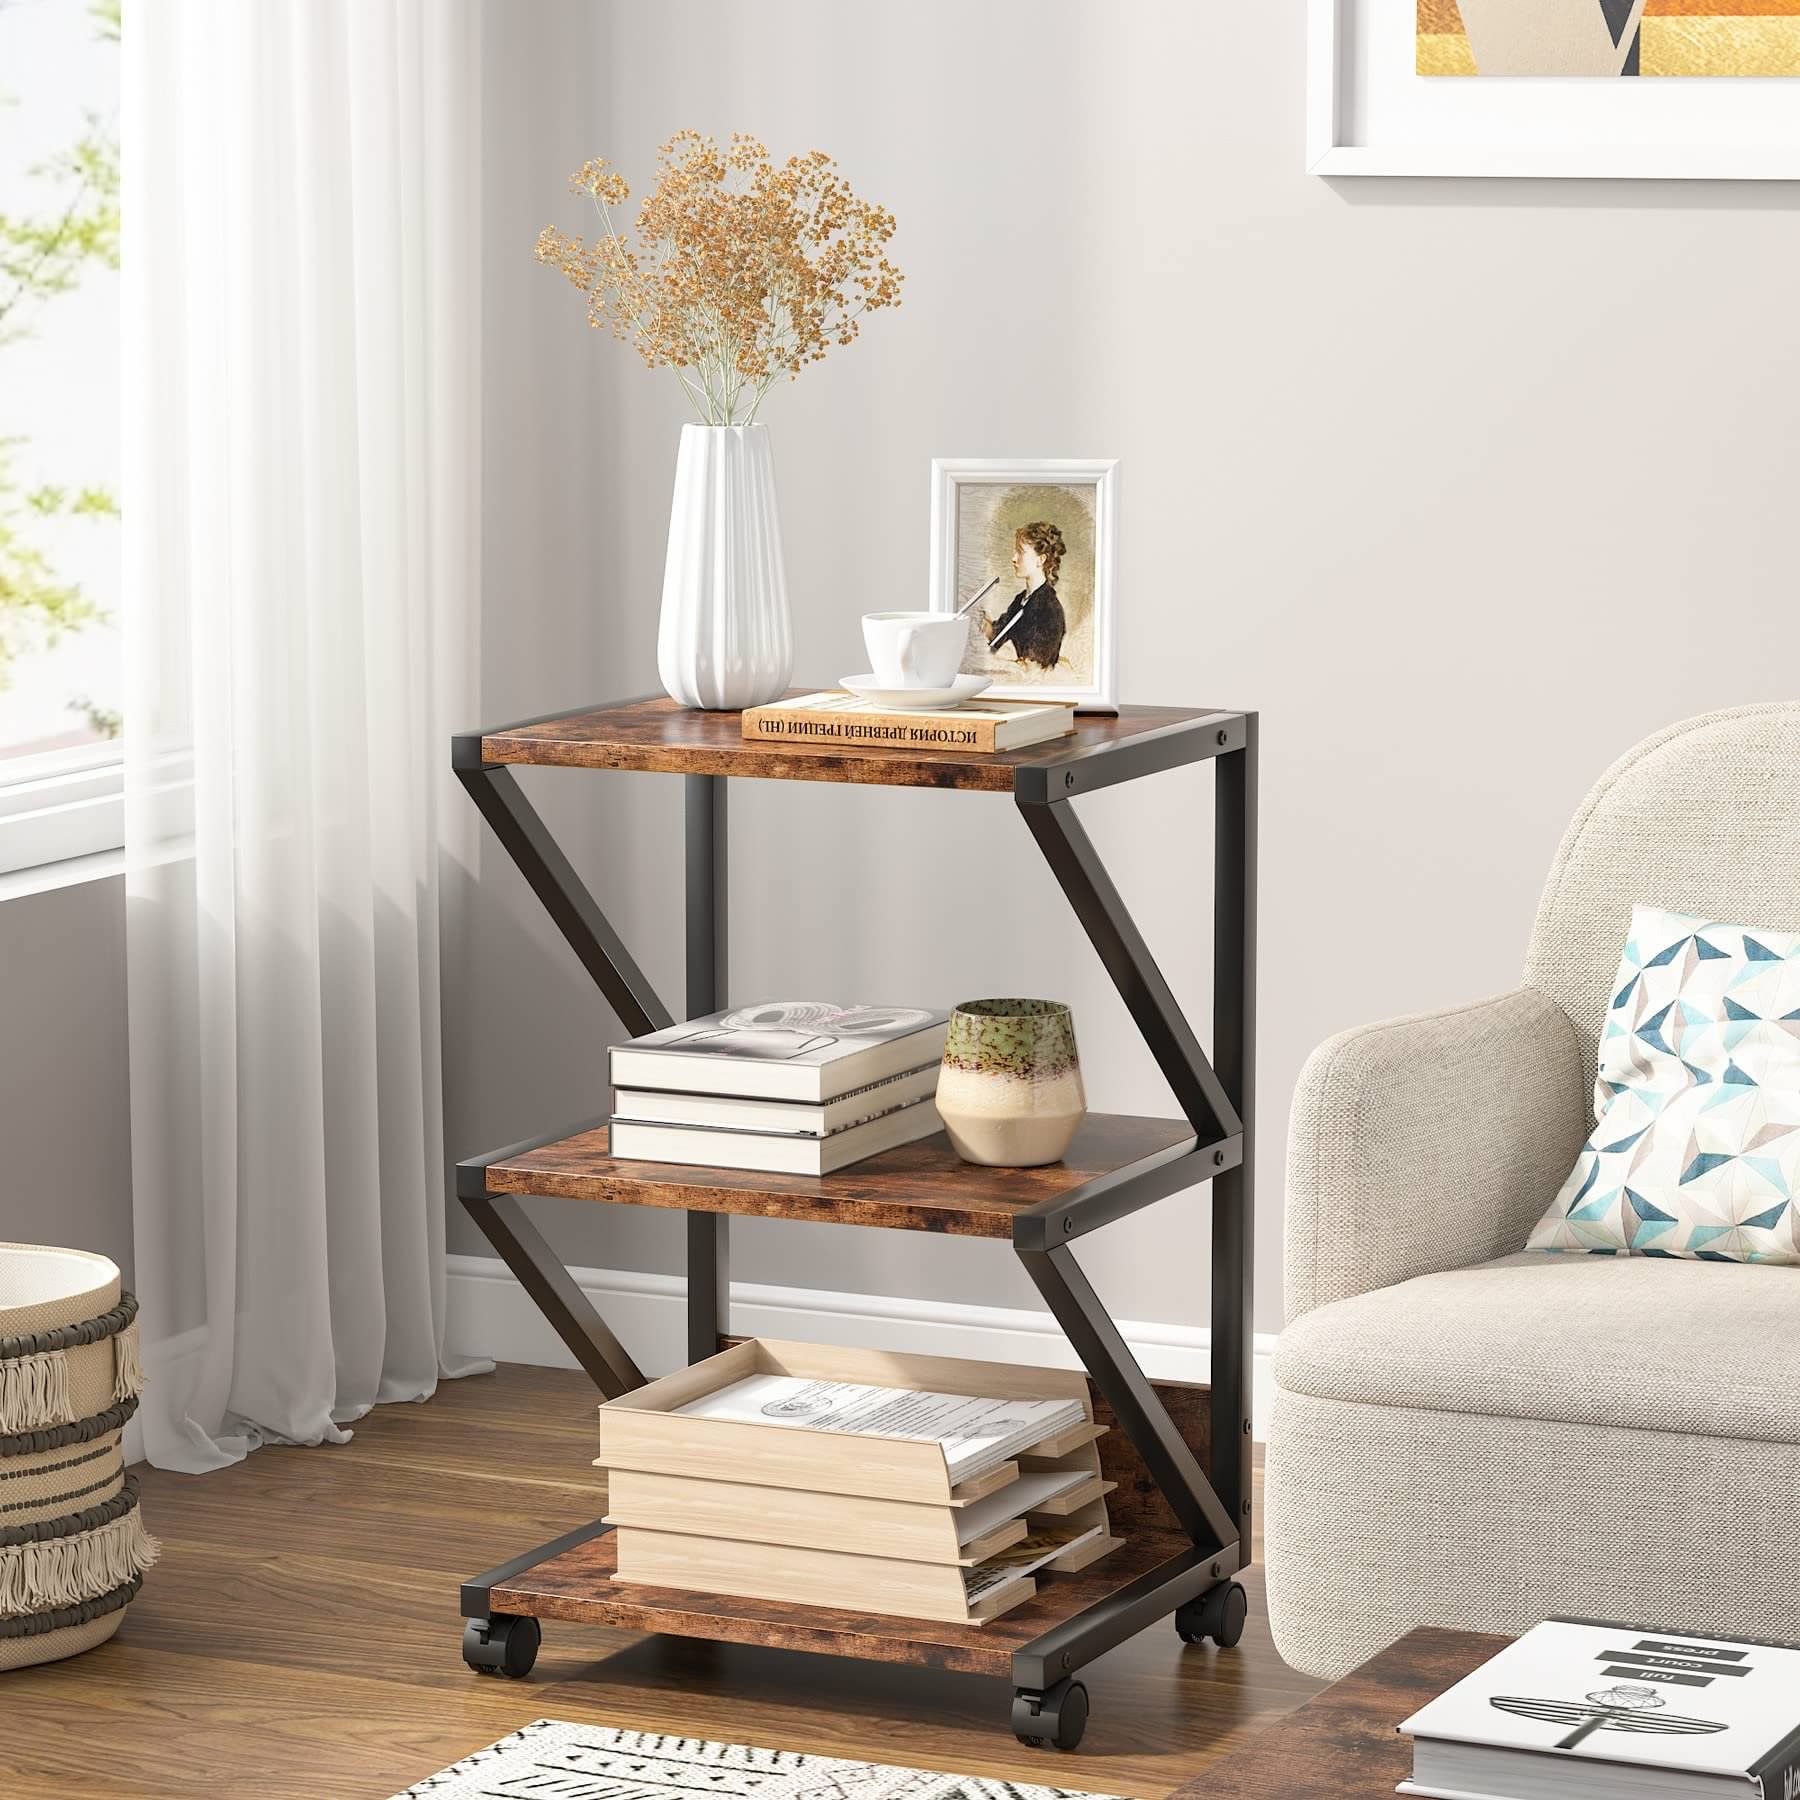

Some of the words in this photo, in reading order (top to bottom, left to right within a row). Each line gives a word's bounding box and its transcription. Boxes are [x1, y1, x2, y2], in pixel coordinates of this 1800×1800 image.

[788, 721, 841, 736] ГРЕЦИИ
[845, 724, 907, 740] ДРЕВНЕЙ
[910, 728, 977, 743] ИСТОРИЯ
[1663, 1645, 1720, 1656] press
[1645, 1657, 1704, 1669] court
[1640, 1671, 1676, 1681] full
